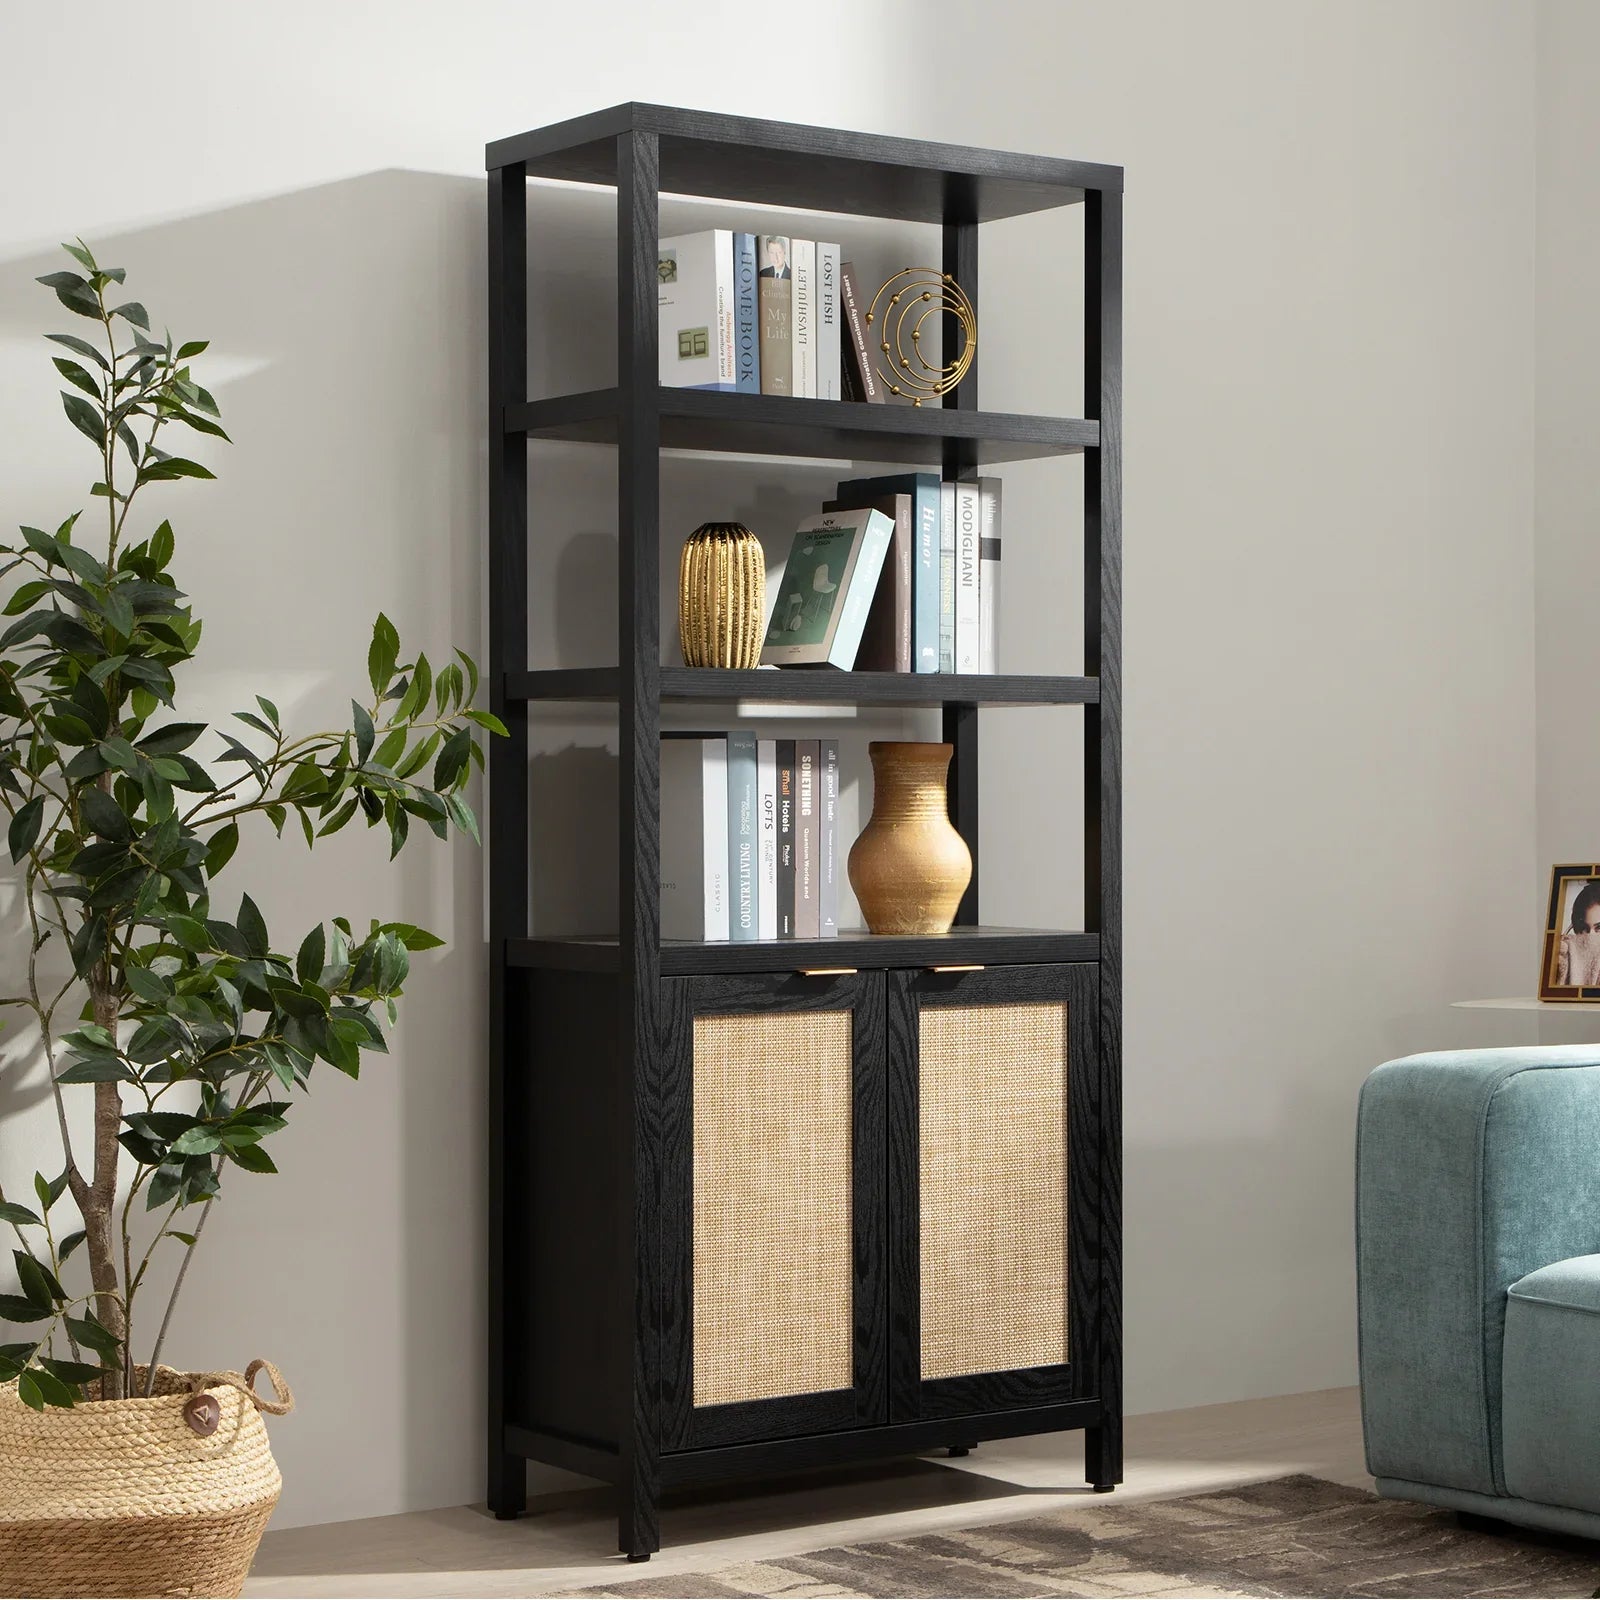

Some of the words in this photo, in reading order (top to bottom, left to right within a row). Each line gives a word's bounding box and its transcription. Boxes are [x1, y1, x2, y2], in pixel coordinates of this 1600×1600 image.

[740, 251, 753, 315] HOME
[823, 255, 833, 290] LOST
[842, 274, 853, 297] heart
[767, 308, 787, 326] My
[798, 266, 808, 345] LIVSHJULET
[824, 294, 833, 325] FISH
[848, 298, 855, 307] in
[766, 326, 789, 340] Life
[740, 321, 754, 382] BOOK
[922, 505, 935, 568] Humor
[962, 496, 973, 587] MODIGLIANI
[828, 763, 835, 773] in
[826, 775, 836, 798] good
[764, 793, 773, 830] LOFTS
[782, 800, 790, 833] Hotels
[740, 843, 751, 879] LIVING
[740, 879, 751, 929] COUNTRY
